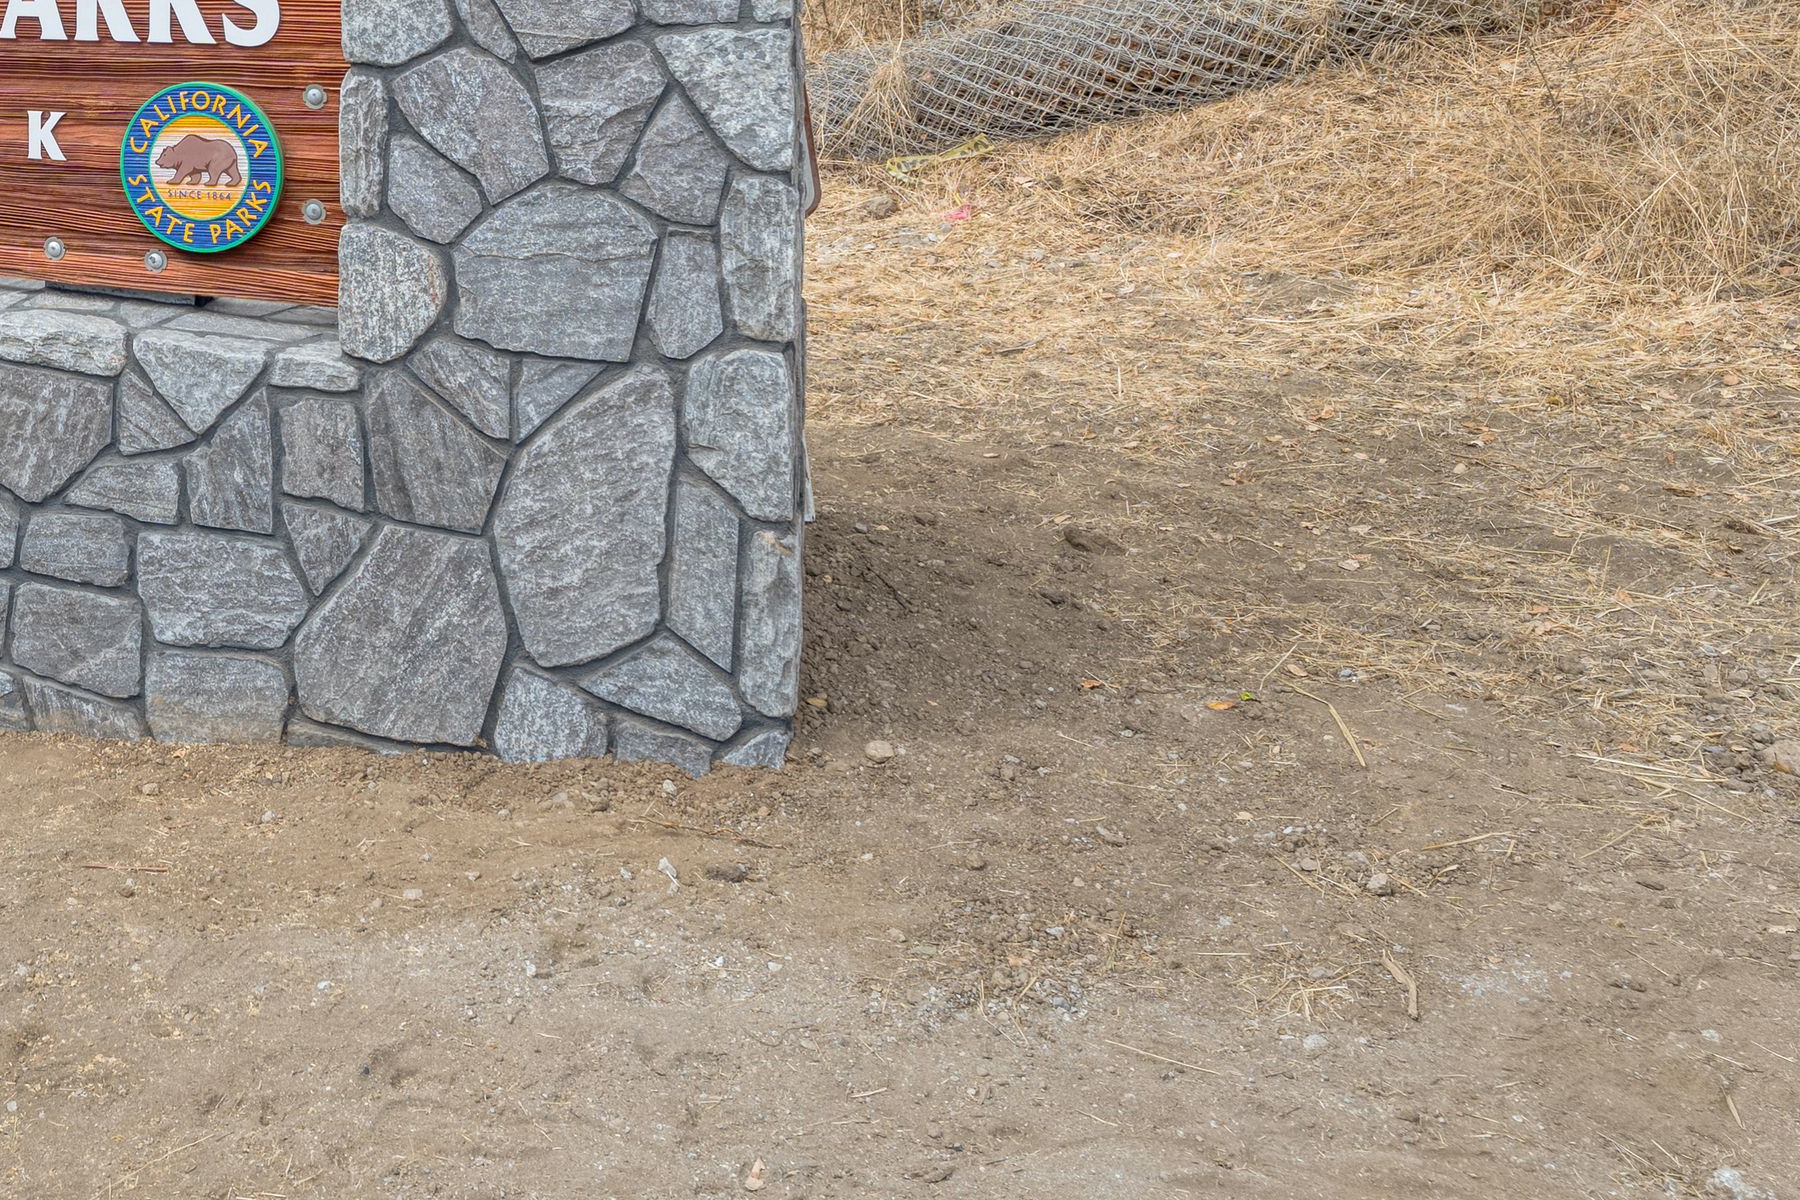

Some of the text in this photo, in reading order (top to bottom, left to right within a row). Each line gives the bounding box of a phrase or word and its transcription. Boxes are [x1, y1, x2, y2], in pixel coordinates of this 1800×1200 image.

[131, 91, 268, 158] CALIFORNIA
[129, 175, 272, 244] STATE PARKS
[167, 188, 232, 201] SINCE 1864
